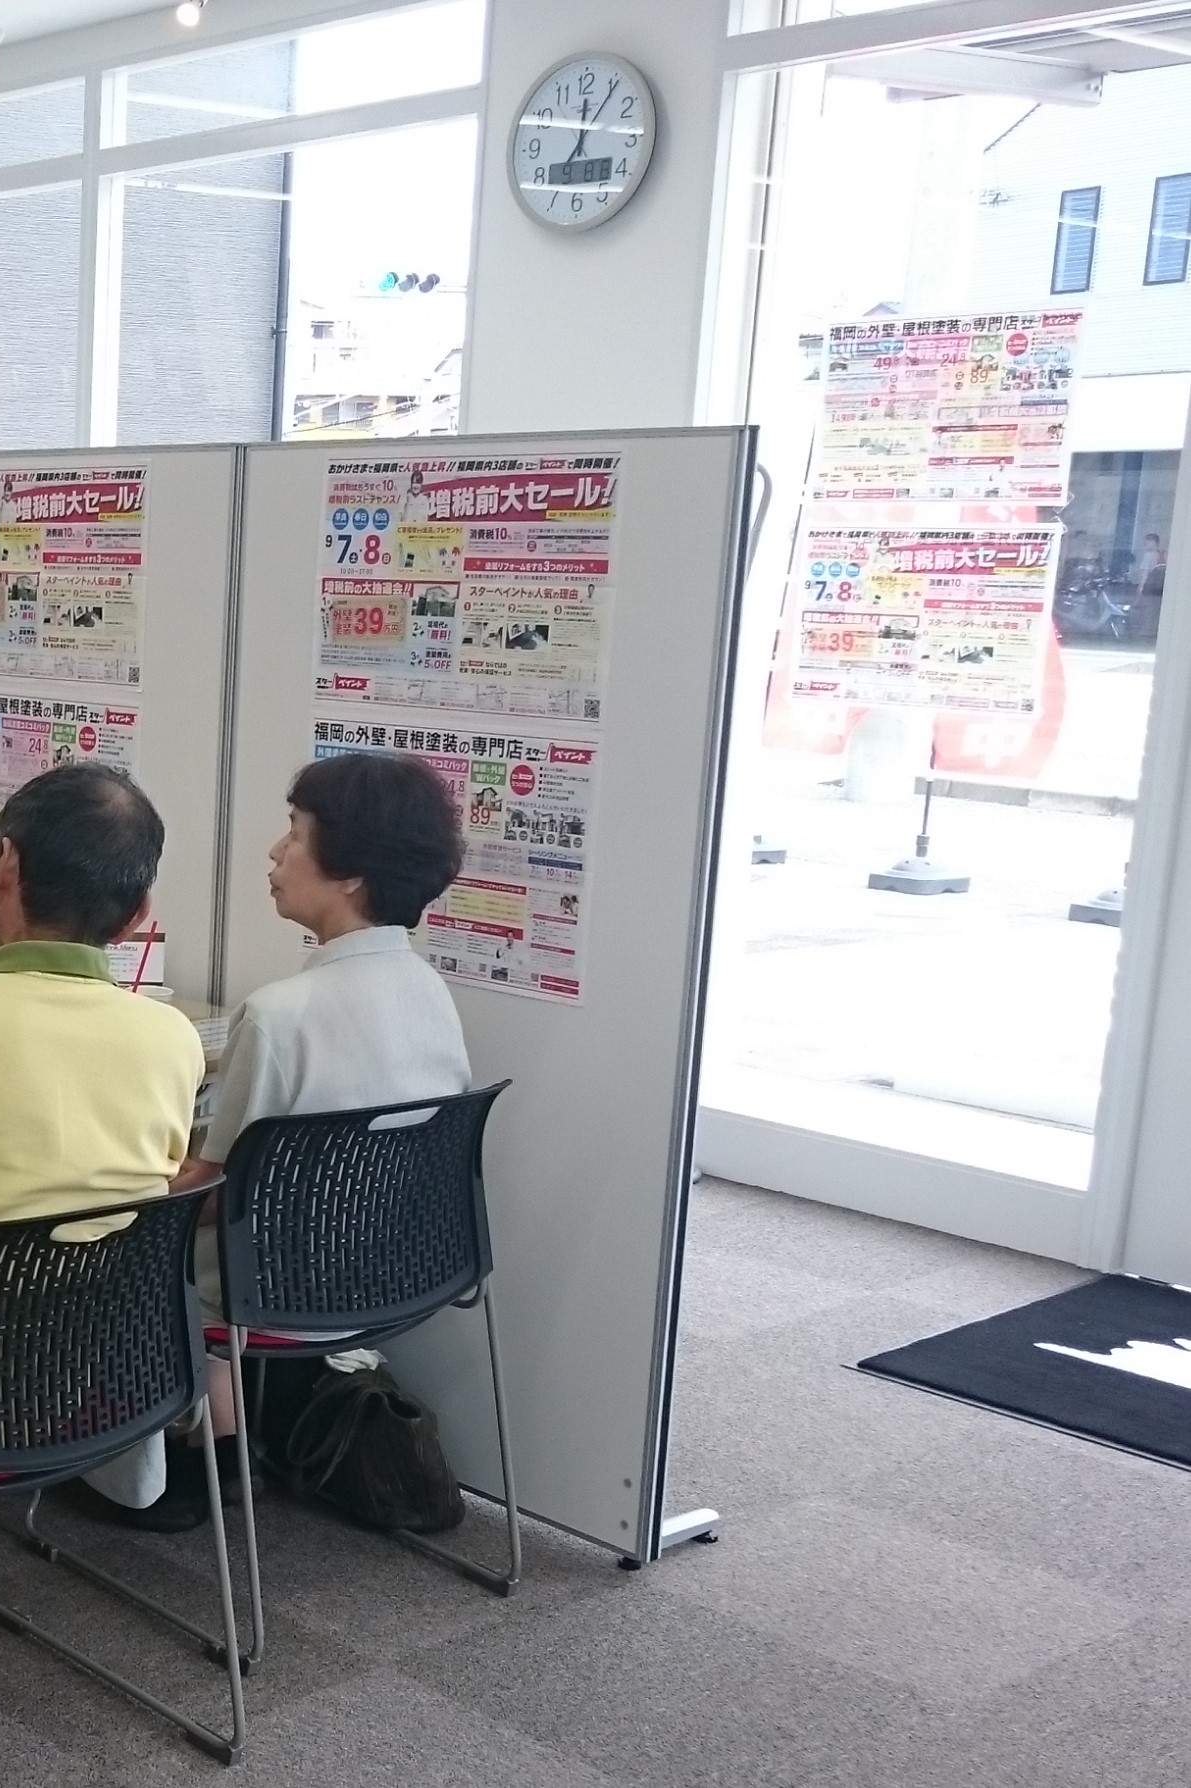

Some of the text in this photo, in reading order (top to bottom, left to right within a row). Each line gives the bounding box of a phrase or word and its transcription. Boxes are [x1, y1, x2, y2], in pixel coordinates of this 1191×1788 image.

[557, 84, 569, 106] 11
[578, 73, 595, 95] 12
[620, 96, 634, 118] 2
[536, 108, 553, 130] 10
[625, 126, 638, 148] 3
[529, 138, 540, 159] 9
[533, 167, 545, 187] 8
[615, 158, 627, 178] 4
[571, 192, 583, 212] 6
[596, 182, 608, 202] 5
[829, 314, 1020, 342] 福岡の外壁・屋根塗装の専門店
[15, 484, 143, 521] 増税前大セール!
[428, 474, 617, 519] 増税前大セール!
[325, 534, 333, 548] 9
[337, 534, 352, 564] 7
[364, 534, 381, 565] 8
[815, 581, 827, 601] 7
[837, 581, 851, 601] 8
[354, 607, 384, 635] 39
[314, 722, 524, 760] 福岡の外壁・屋根塗装の専門店
[555, 750, 586, 761] ペイント
[470, 806, 491, 825] 89
